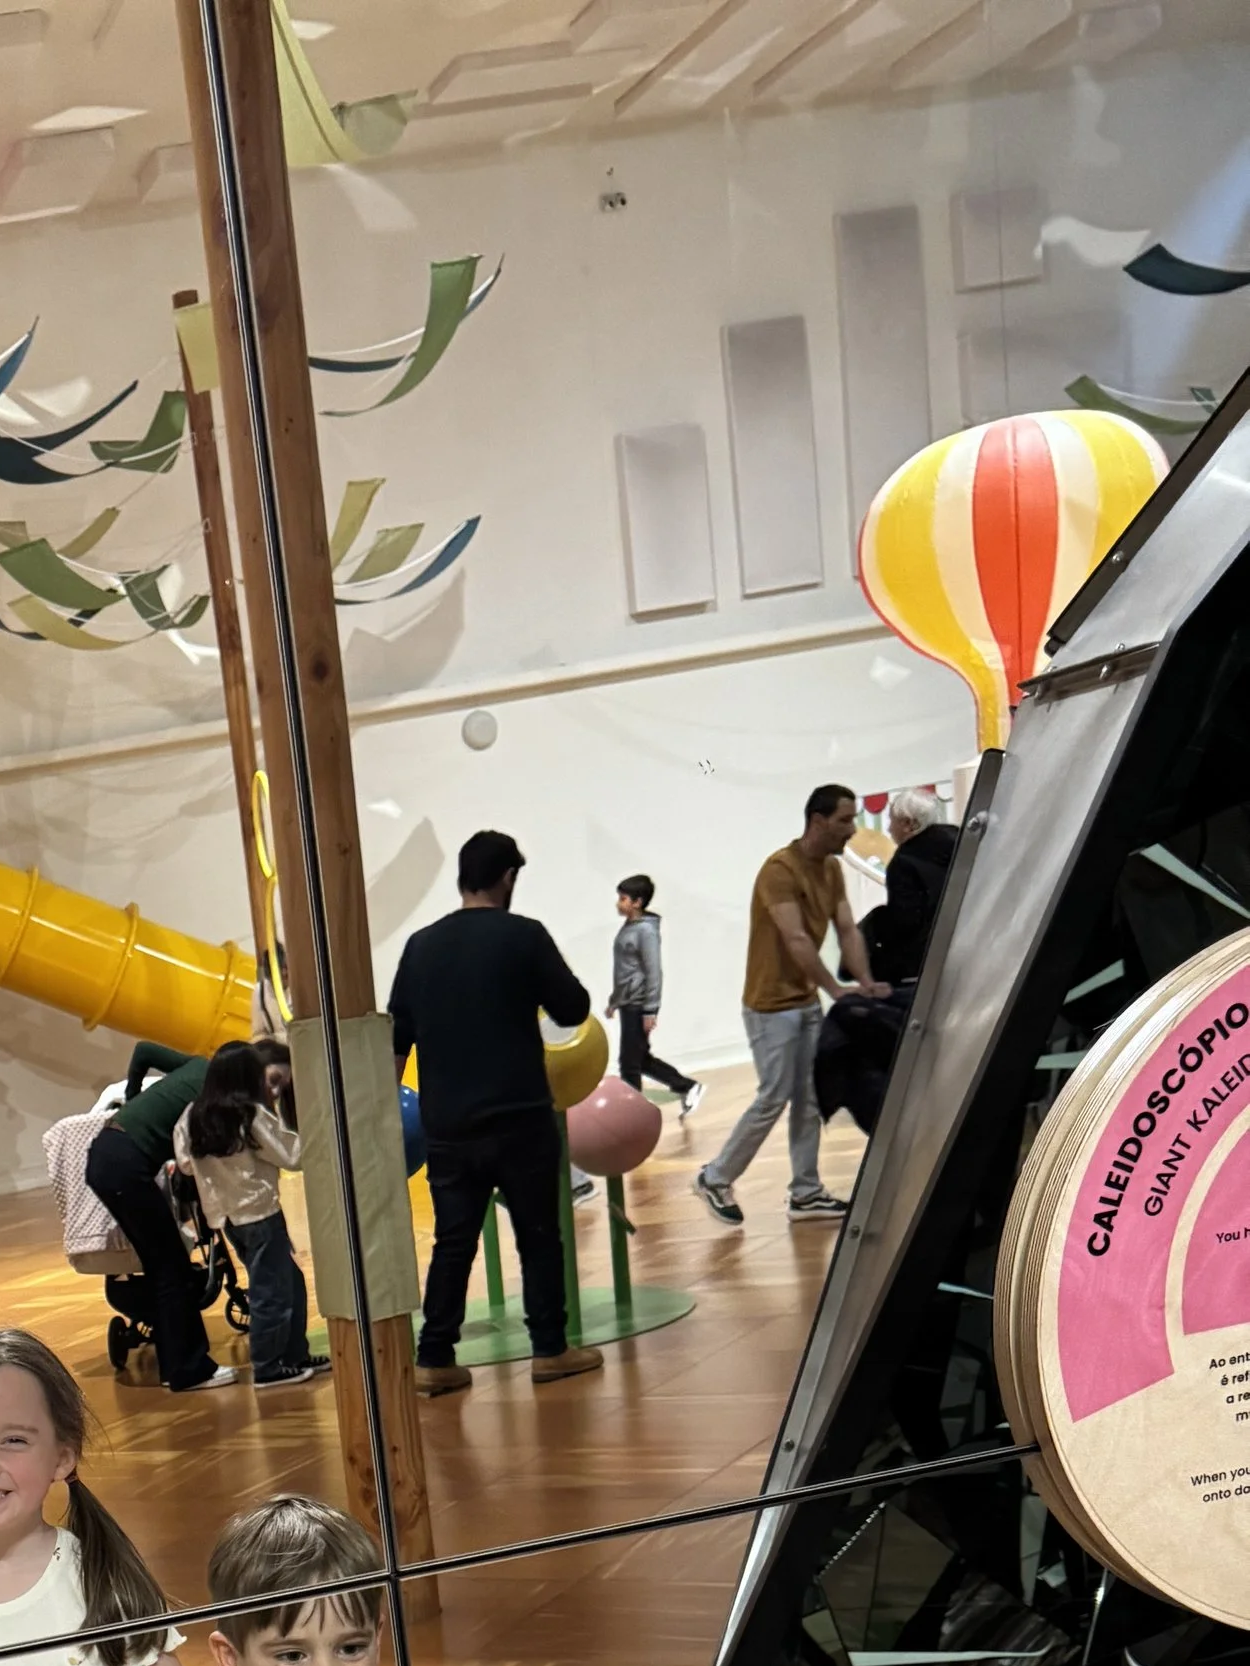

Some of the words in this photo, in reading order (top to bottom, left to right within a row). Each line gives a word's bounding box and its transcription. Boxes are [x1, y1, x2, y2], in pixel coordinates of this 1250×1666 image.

[1087, 1002, 1250, 1257] CALEIDOSCÓPIO
[1144, 1133, 1191, 1217] GIANT
[1216, 1231, 1241, 1244] You
[1209, 1358, 1226, 1370] Ao
[1221, 1374, 1229, 1386] é
[1226, 1395, 1235, 1404] a
[1190, 1471, 1227, 1486] When
[1203, 1489, 1231, 1502] onto
